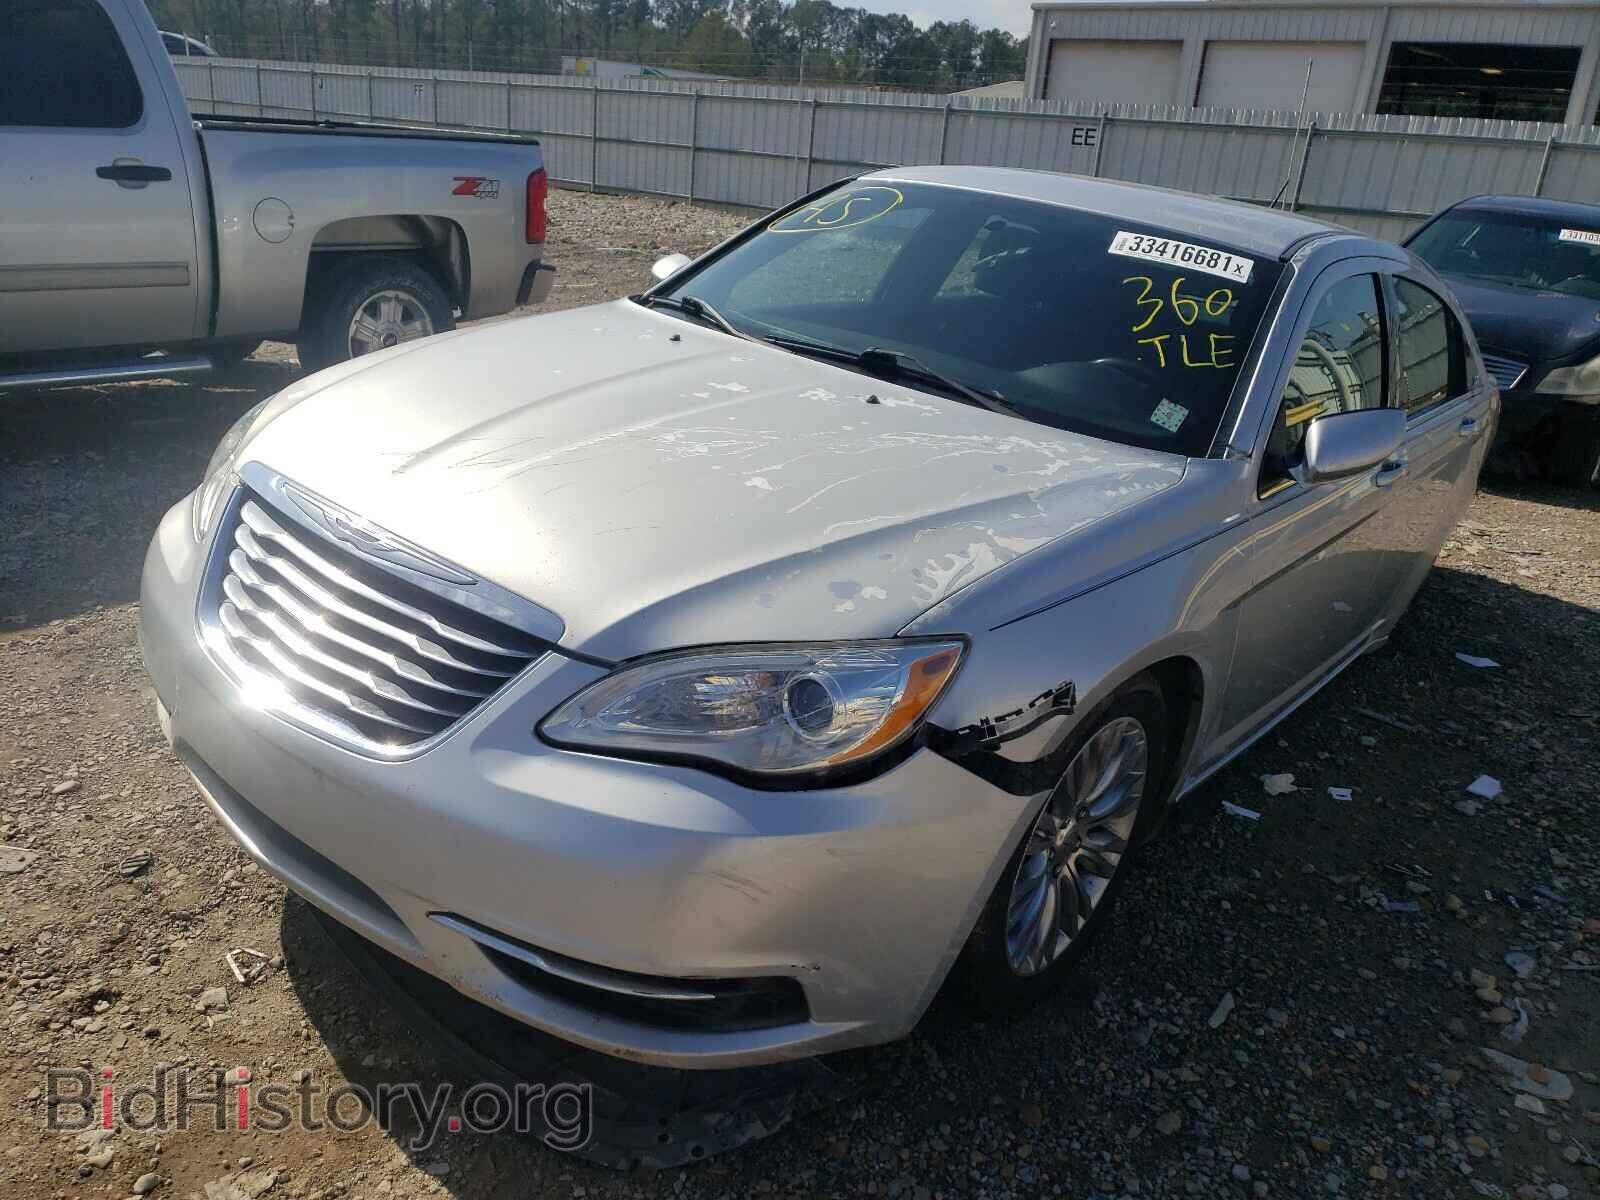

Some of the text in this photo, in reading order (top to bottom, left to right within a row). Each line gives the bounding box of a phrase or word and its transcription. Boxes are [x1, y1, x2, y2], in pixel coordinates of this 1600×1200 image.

[1071, 127, 1097, 146] EE
[1123, 276, 1233, 332] 360
[1137, 333, 1236, 368] TLE
